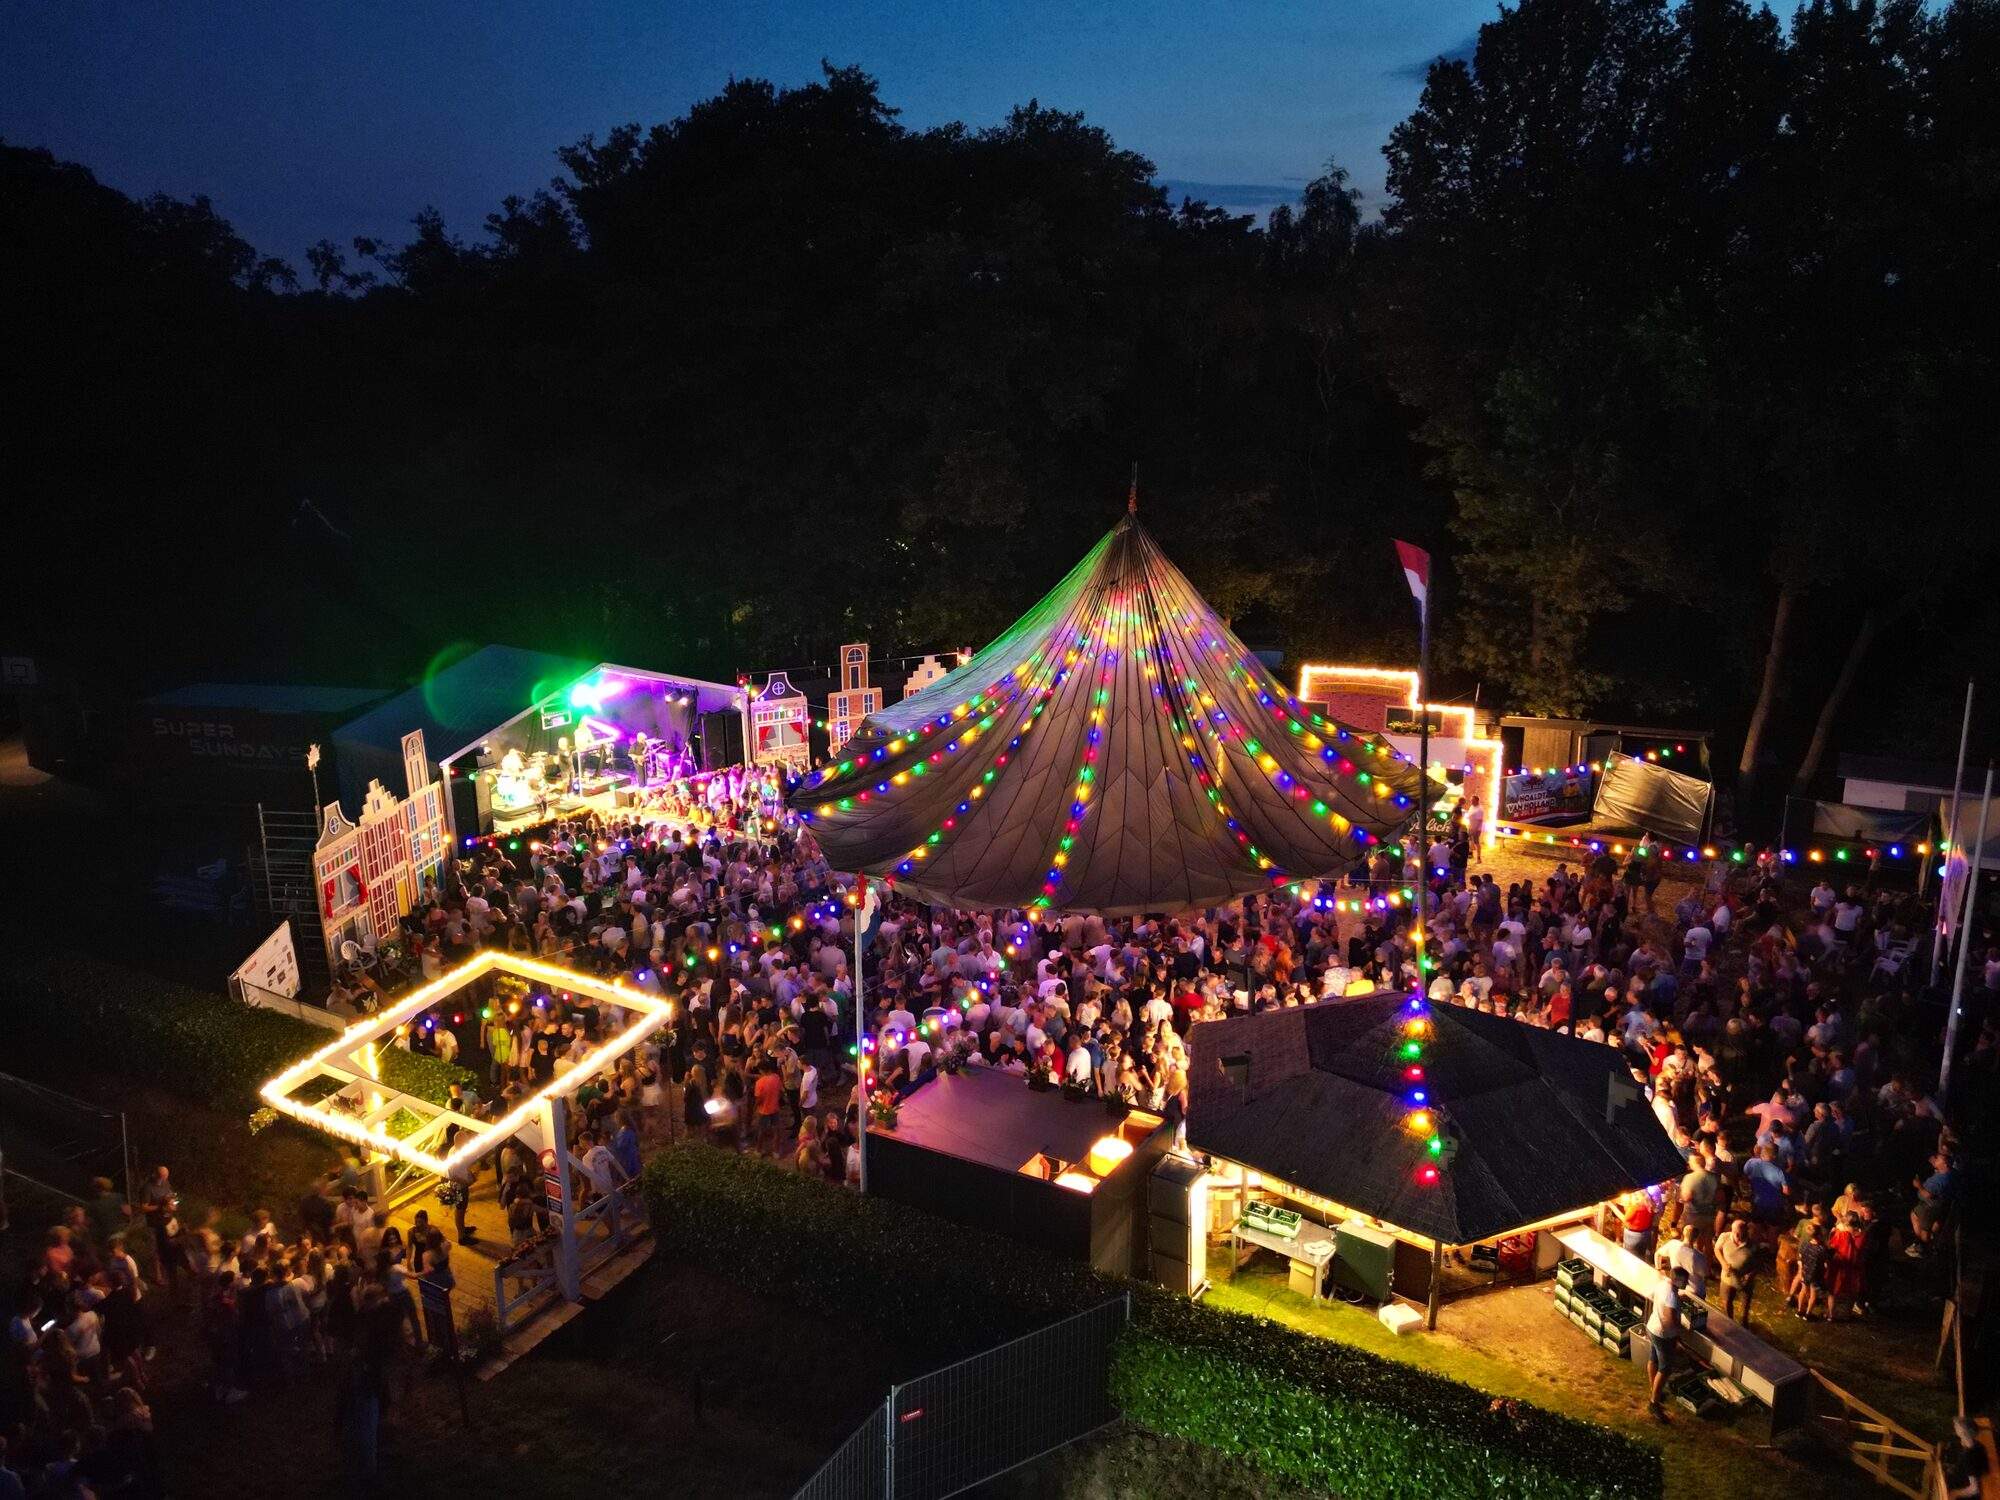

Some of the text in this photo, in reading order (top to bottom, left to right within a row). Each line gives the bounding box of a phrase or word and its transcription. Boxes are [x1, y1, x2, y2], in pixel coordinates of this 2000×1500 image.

[152, 718, 235, 739] SUPER
[190, 738, 303, 761] SUNDAYS
[1506, 800, 1523, 814] VAN
